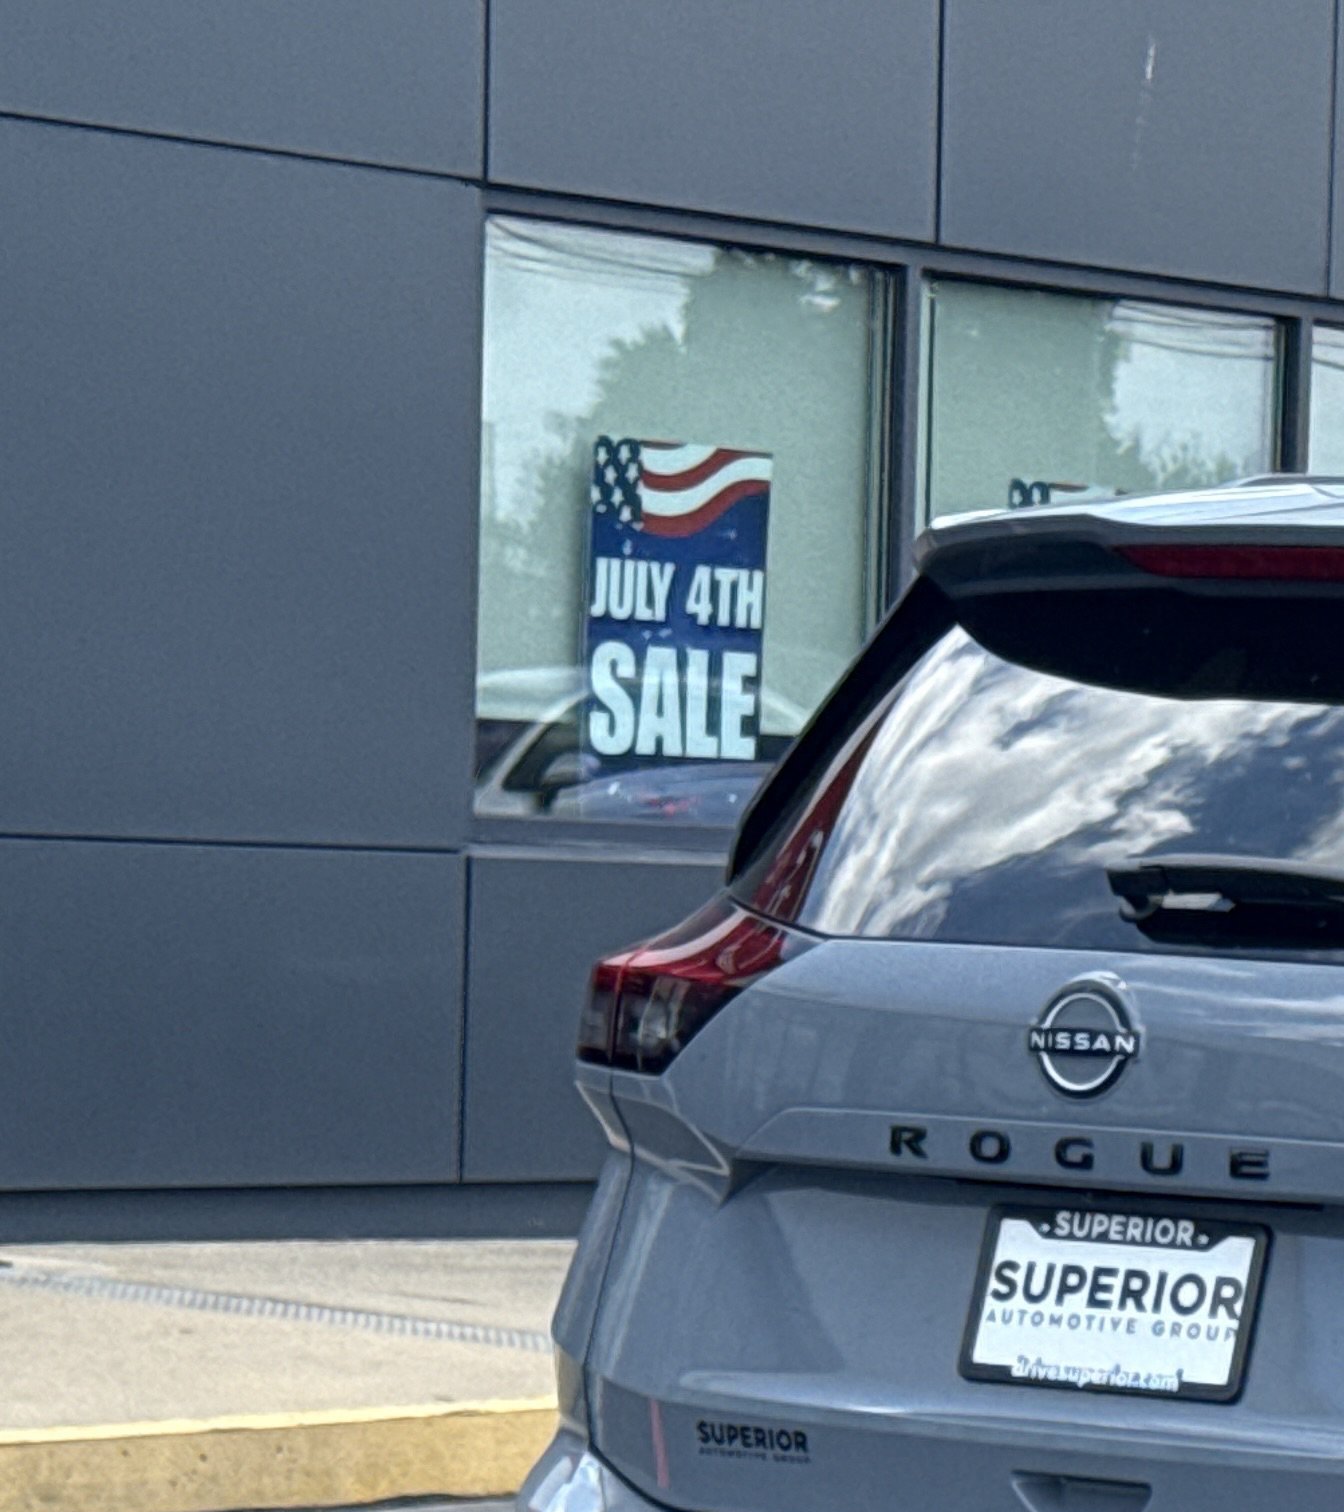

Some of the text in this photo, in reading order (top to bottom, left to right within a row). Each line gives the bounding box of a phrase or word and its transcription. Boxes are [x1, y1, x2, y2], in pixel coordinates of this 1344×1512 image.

[590, 557, 764, 630] JULY 4TH
[589, 640, 757, 761] SALE
[1030, 1030, 1136, 1054] NISSAN
[889, 1125, 1271, 1181] ROGUE
[1053, 1209, 1195, 1247] SUPERIOR
[990, 1259, 1244, 1321] SUPERIOR
[985, 1308, 1138, 1335] AUTOMOTIVE
[696, 1420, 809, 1453] SUPERIOR
